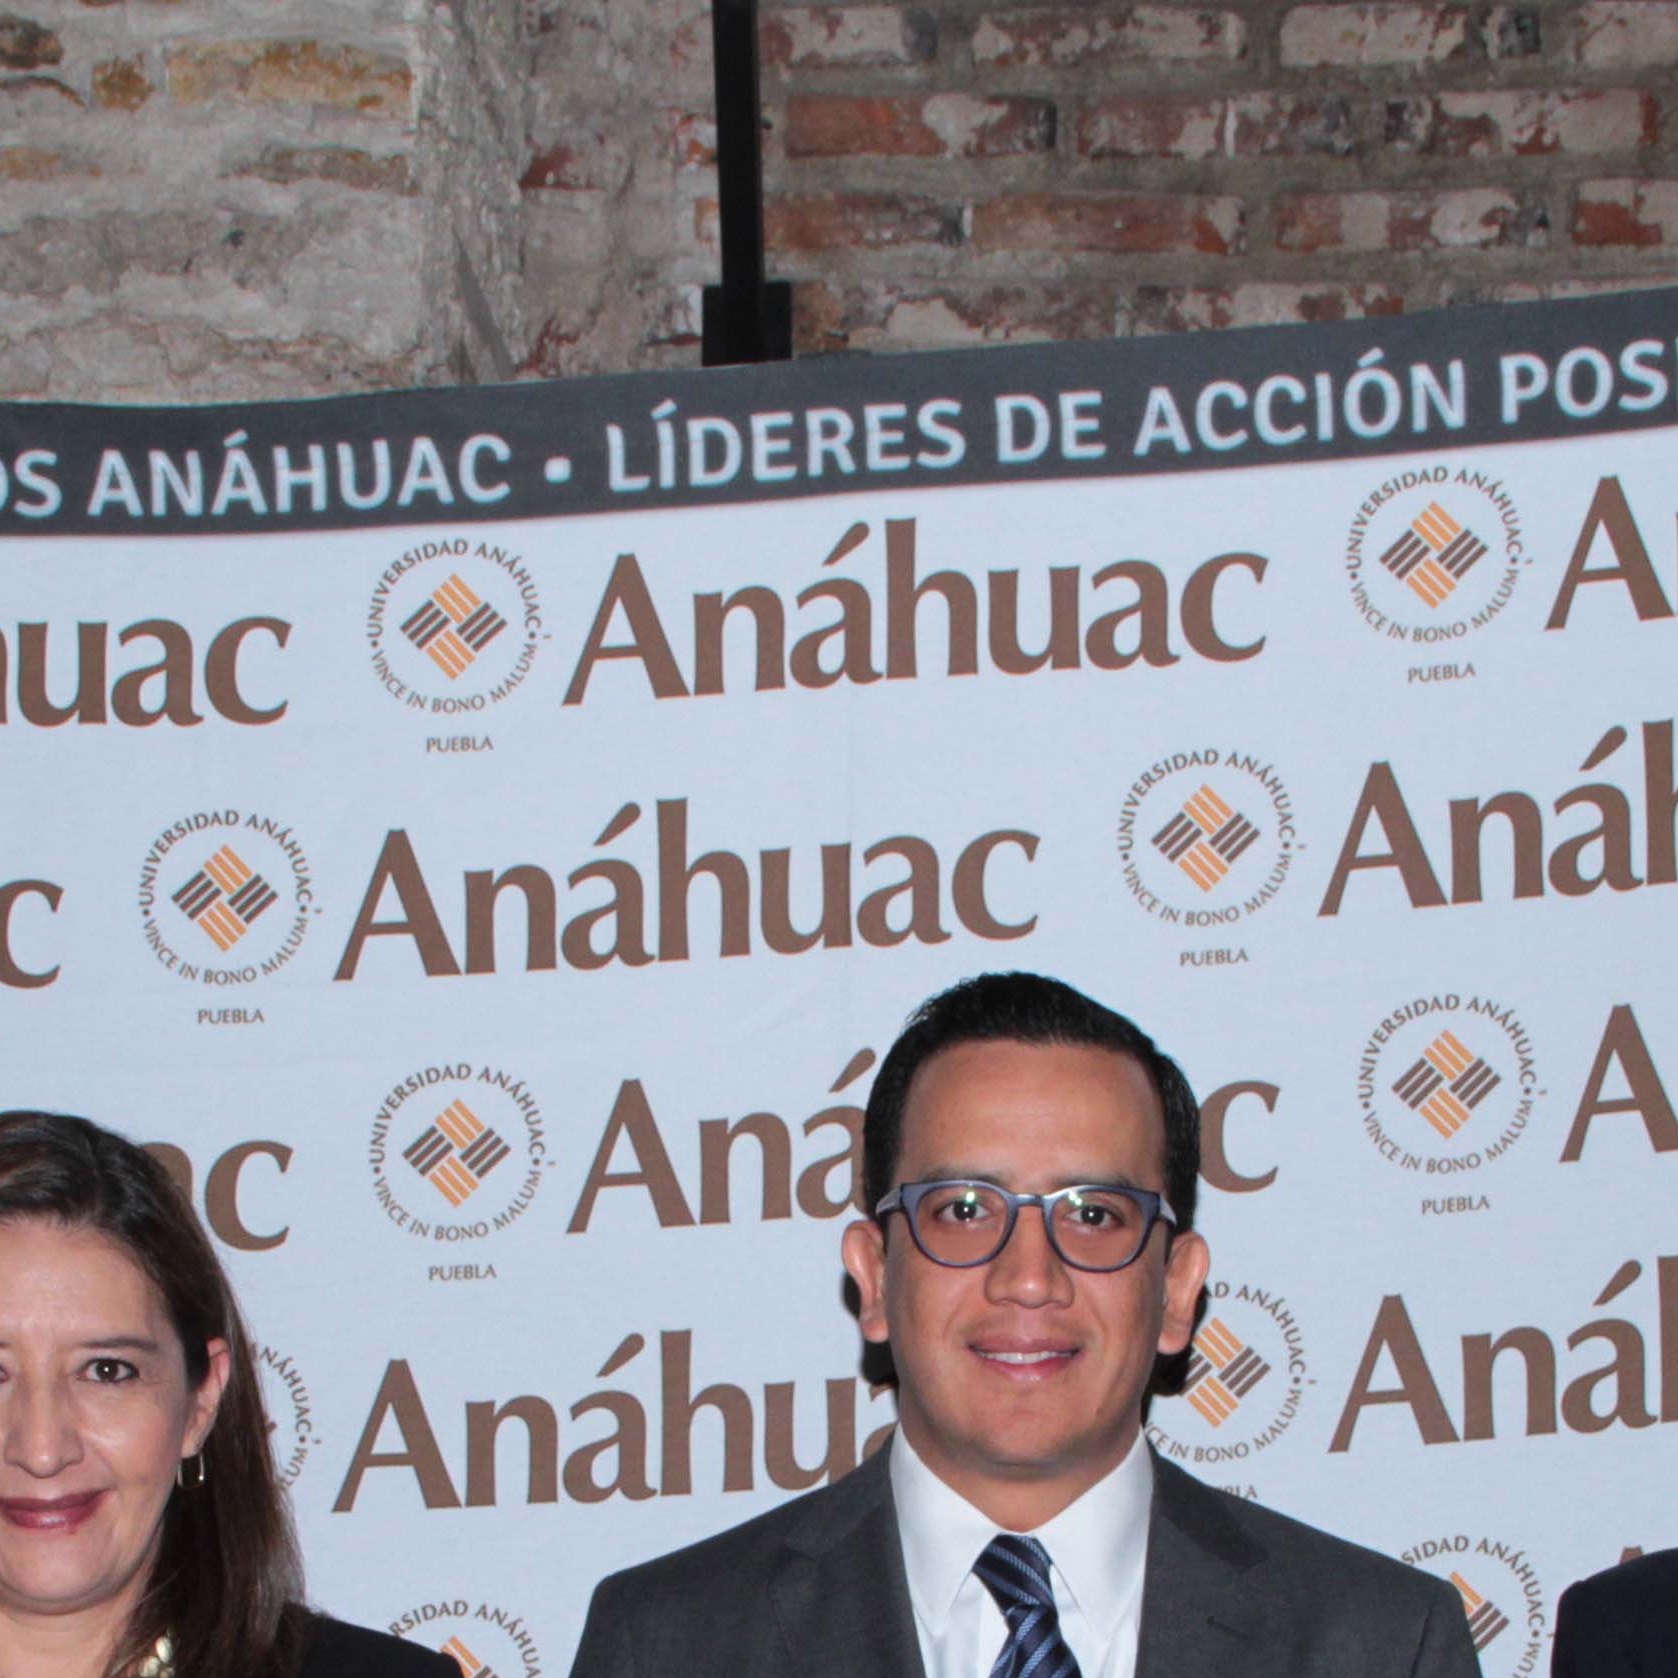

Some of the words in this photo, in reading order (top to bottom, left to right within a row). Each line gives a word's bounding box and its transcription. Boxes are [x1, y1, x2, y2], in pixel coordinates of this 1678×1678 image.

[86, 429, 512, 518] ANÁHUAC
[606, 399, 967, 493] LÍDERES
[994, 390, 1107, 465] DE
[1133, 347, 1467, 456] ACCIÓN
[1345, 465, 1449, 571] UNIVERSIDAD
[1453, 468, 1525, 555] ANÁHUAC
[365, 537, 469, 639] UNIVERSIDAD
[473, 541, 543, 630] ANÁHUAC
[562, 517, 1268, 705] Anáhuac
[1349, 580, 1389, 632] VINCE
[1386, 621, 1409, 641] IN
[1411, 620, 1468, 643] BONO
[1470, 567, 1521, 631] MALUM
[370, 648, 408, 700] VINCE
[405, 691, 429, 710] IN
[430, 693, 486, 714] BONO
[488, 642, 539, 704] MALUM
[1406, 662, 1477, 684] PUEBLA
[424, 734, 494, 754] PUEBLA
[1116, 747, 1220, 852] UNIVERSIDAD
[1224, 751, 1297, 840] ANÁHUAC
[137, 808, 240, 908] UNIVERSIDAD
[244, 813, 314, 903] ANÁHUAC
[333, 798, 1040, 982] Anáhuac
[1121, 861, 1161, 914] VINCE
[1158, 904, 1182, 924] IN
[1184, 905, 1241, 927] BONO
[1243, 852, 1293, 916] MALUM
[141, 917, 180, 970] VINCE
[177, 961, 200, 982] IN
[202, 965, 258, 986] BONO
[260, 915, 310, 977] MALUM
[1179, 947, 1250, 968] PUEBLA
[196, 1007, 266, 1026] PUEBLA
[1357, 992, 1461, 1100] UNIVERSIDAD
[1465, 996, 1538, 1085] ANÁHUAC
[368, 1062, 473, 1165] UNIVERSIDAD
[476, 1066, 547, 1156] ANÁHUAC
[1362, 1109, 1402, 1162] VINCE
[1399, 1152, 1423, 1172] IN
[1425, 1152, 1482, 1175] BONO
[1484, 1097, 1534, 1163] MALUM
[372, 1174, 411, 1228] VINCE
[407, 1218, 431, 1238] IN
[433, 1220, 490, 1242] BONO
[492, 1168, 543, 1232] MALUM
[1420, 1194, 1491, 1216] PUEBLA
[427, 1263, 498, 1283] PUEBLA
[1235, 1284, 1307, 1375] ANÁHUAC
[1168, 1440, 1190, 1460] IN
[1194, 1442, 1250, 1463] BONO
[1253, 1388, 1304, 1452] MALUM
